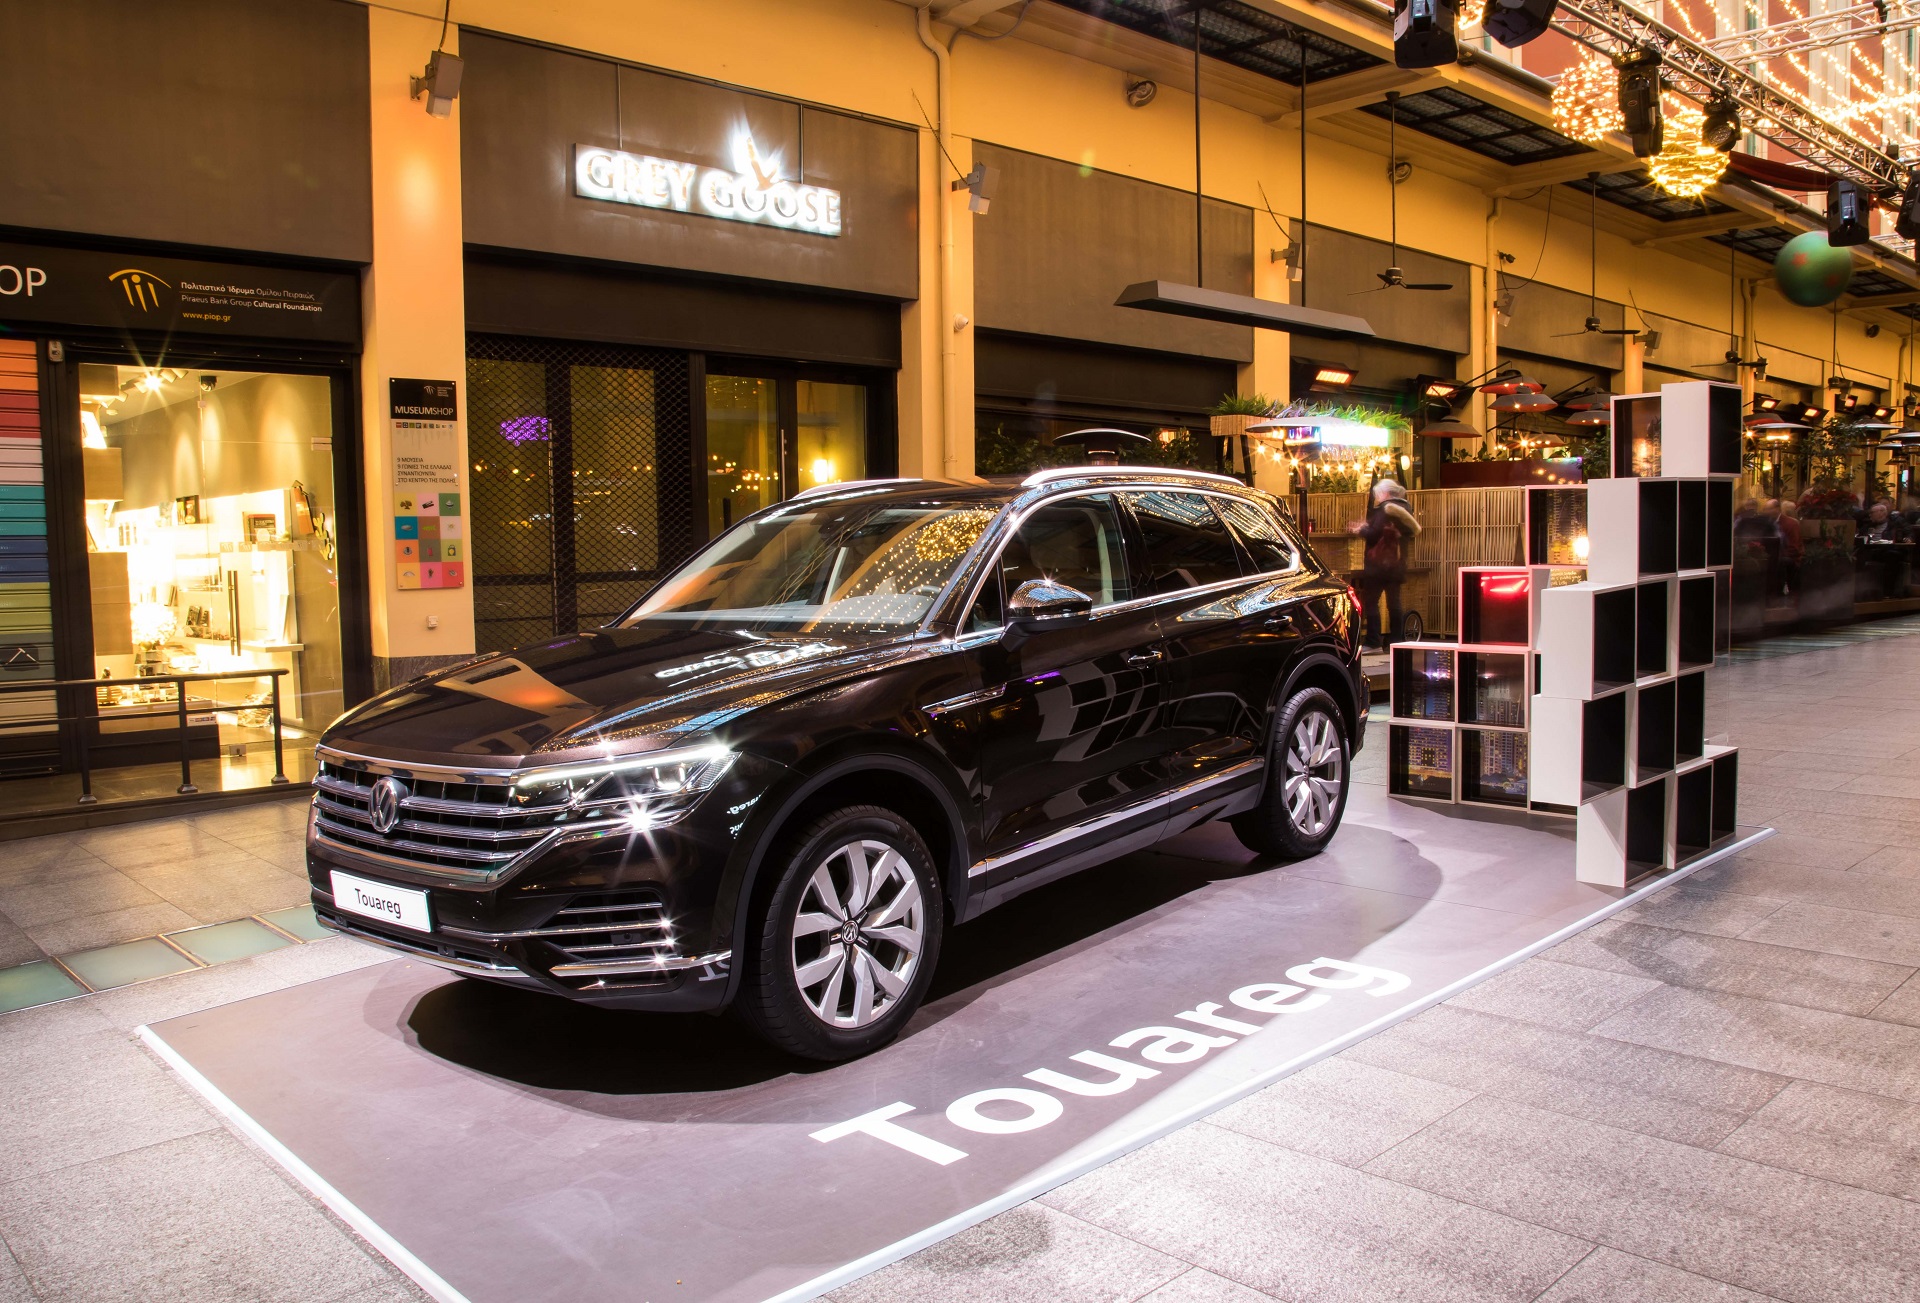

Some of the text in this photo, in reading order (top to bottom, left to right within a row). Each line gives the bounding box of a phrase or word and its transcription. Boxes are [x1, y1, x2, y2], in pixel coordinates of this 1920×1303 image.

[586, 153, 840, 226] GREY GOOSE
[0, 265, 47, 296] OP
[181, 281, 226, 293] Πολιτιστικό
[226, 284, 255, 296] Ίδρυμα
[256, 287, 282, 298] Ομίλου
[181, 295, 323, 313] Piraeus Bank Group Cultural Foundation
[182, 311, 232, 323] www.piop.gr
[394, 405, 454, 416] MUSEUMSHOP
[354, 887, 402, 919] Touareg
[808, 955, 1411, 1167] Touareg
